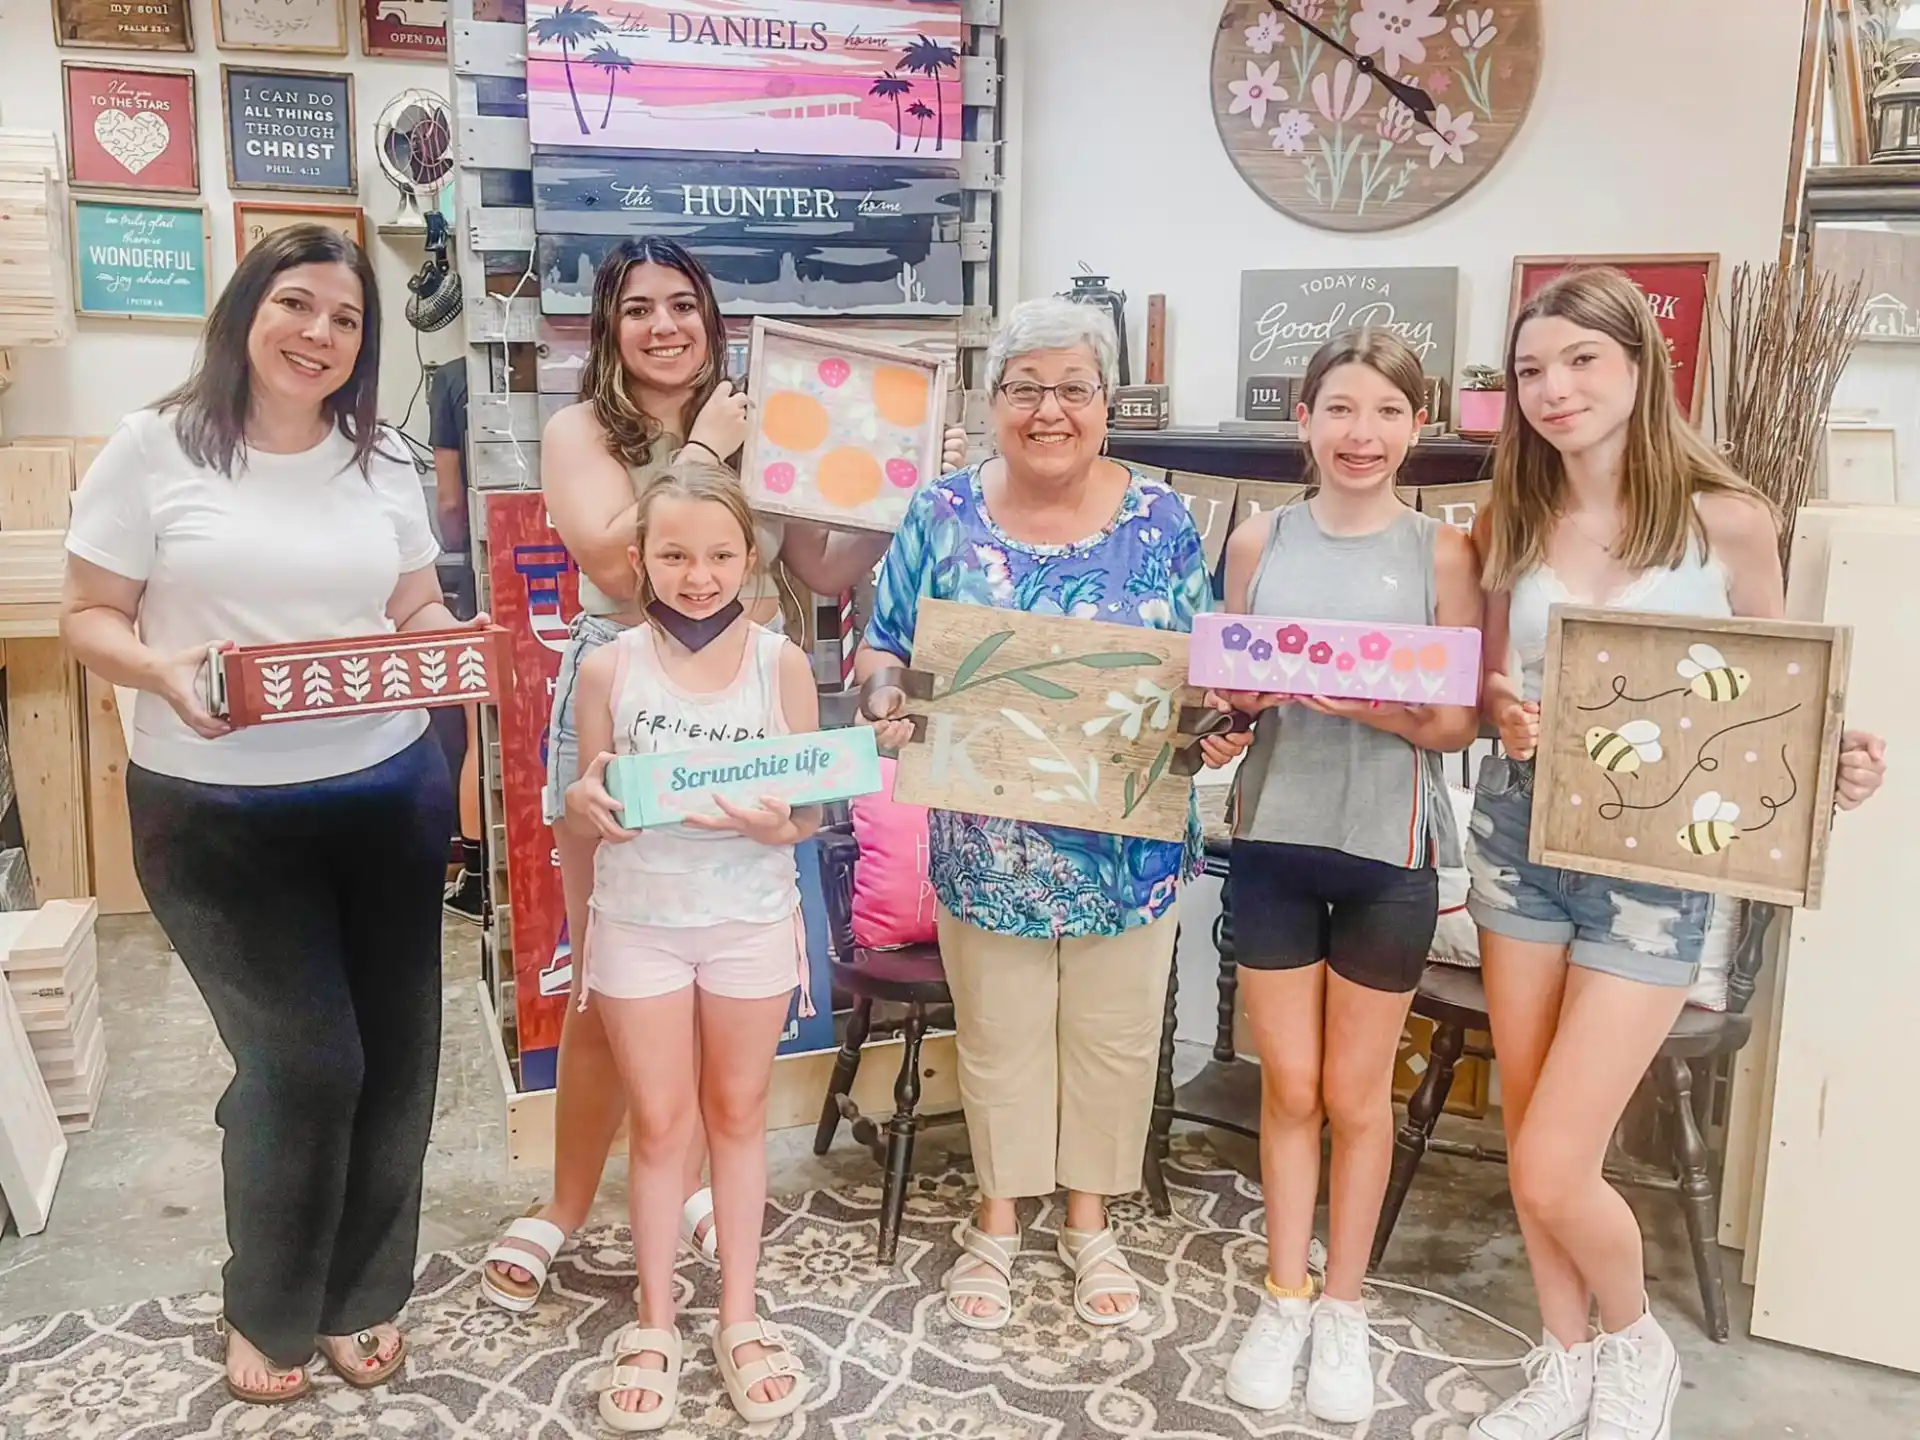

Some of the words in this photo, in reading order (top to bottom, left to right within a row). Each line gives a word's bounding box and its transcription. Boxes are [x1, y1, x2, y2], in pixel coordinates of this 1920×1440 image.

[110, 3, 132, 14] my
[137, 4, 168, 14] soul
[390, 32, 422, 44] OPEN
[425, 35, 446, 45] DAI
[607, 8, 649, 33] the
[667, 12, 828, 51] DANIELS
[843, 24, 889, 48] home
[90, 95, 106, 105] TO
[110, 96, 133, 108] THE
[136, 98, 170, 111] STARS
[244, 89, 250, 100] I
[259, 90, 298, 103] CAN
[307, 93, 334, 106] DO
[244, 106, 272, 118] ALL
[276, 107, 334, 122] THINGS
[245, 122, 336, 139] THROUGH
[246, 140, 336, 160] CHRIST
[610, 182, 653, 206] the
[681, 184, 838, 219] HUNTER
[857, 190, 902, 212] home
[120, 212, 146, 235] truly
[147, 213, 176, 236] glad
[89, 245, 196, 271] WONDERFUL
[106, 271, 132, 293] joy
[136, 270, 175, 286] ahead
[1300, 273, 1356, 297] TODAY
[1360, 275, 1377, 291] IS
[1377, 283, 1391, 297] A
[1647, 293, 1681, 320] RK
[1249, 302, 1346, 362] Good
[1348, 302, 1438, 361] Day
[1283, 356, 1298, 367] AT
[1251, 388, 1281, 403] JUL
[670, 754, 789, 792] Scrunchie
[794, 744, 831, 776] life
